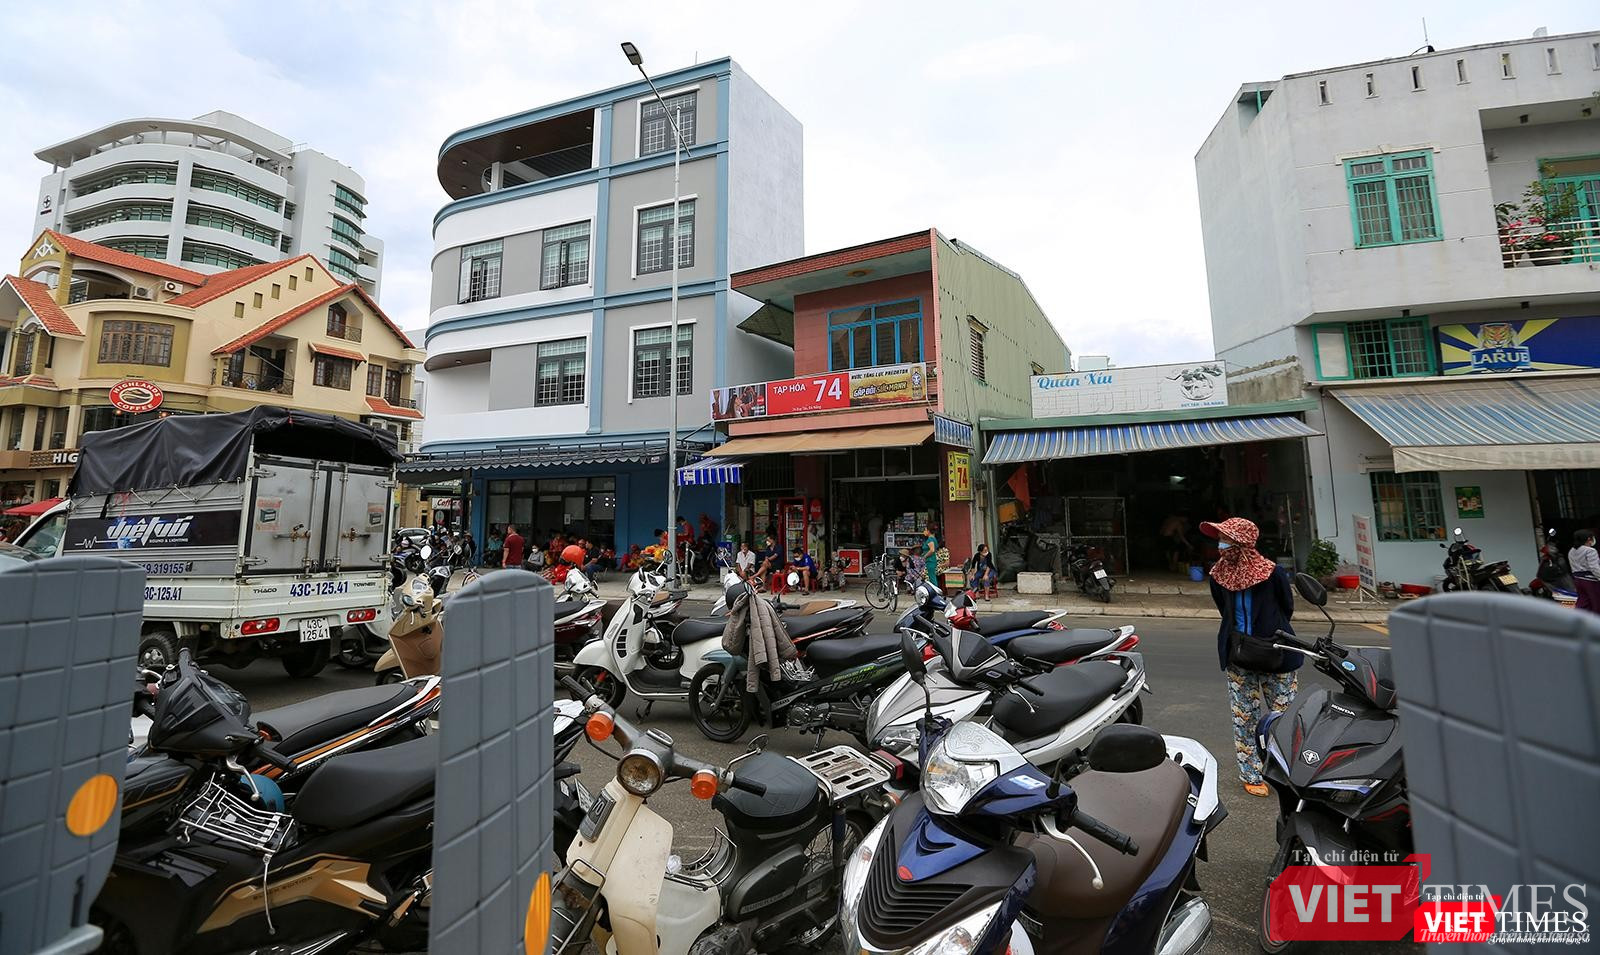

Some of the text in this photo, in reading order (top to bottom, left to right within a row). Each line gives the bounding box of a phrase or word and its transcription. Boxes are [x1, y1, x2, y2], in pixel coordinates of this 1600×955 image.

[1037, 372, 1112, 390] Quán Xíu
[113, 381, 160, 397] HIGHLANDS
[773, 382, 806, 396] TẠP HÓA
[813, 378, 842, 402] 74
[117, 401, 153, 410] COFFEE
[53, 452, 80, 464] HIG
[958, 468, 968, 488] 74
[144, 586, 182, 600] 3C-125.41
[290, 581, 349, 597] 43C-125.41
[307, 620, 322, 628] 43C
[1331, 704, 1356, 716] HONDA
